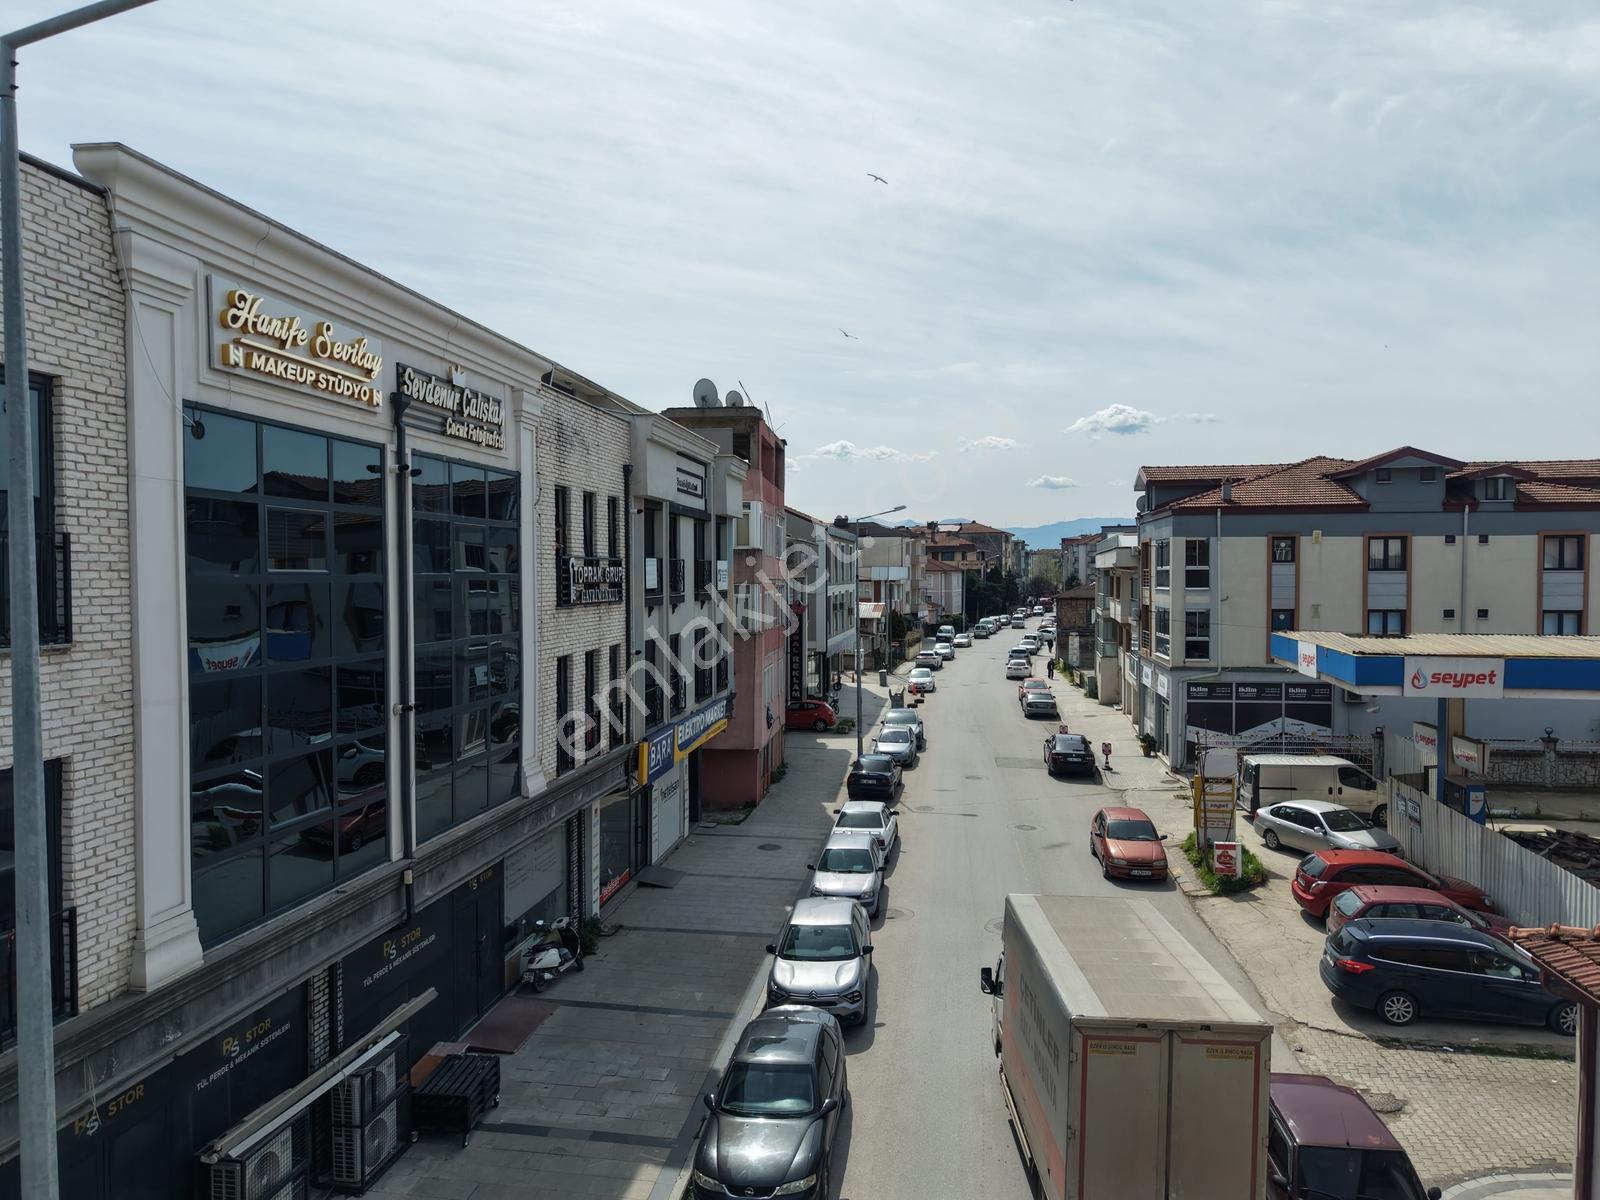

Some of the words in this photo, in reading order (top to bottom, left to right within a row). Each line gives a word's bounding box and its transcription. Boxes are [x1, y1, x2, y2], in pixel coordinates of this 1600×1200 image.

[224, 290, 309, 350] Hanife
[313, 321, 383, 379] Sevilay
[250, 352, 317, 386] MAKEUP
[317, 374, 370, 402] STÜDYO
[404, 367, 461, 412] Sevdenur
[1430, 669, 1497, 689] seypet
[401, 927, 421, 948] STOR
[245, 1018, 272, 1043] STOR
[209, 1064, 230, 1083] PERDE
[108, 1083, 145, 1117] STOR
